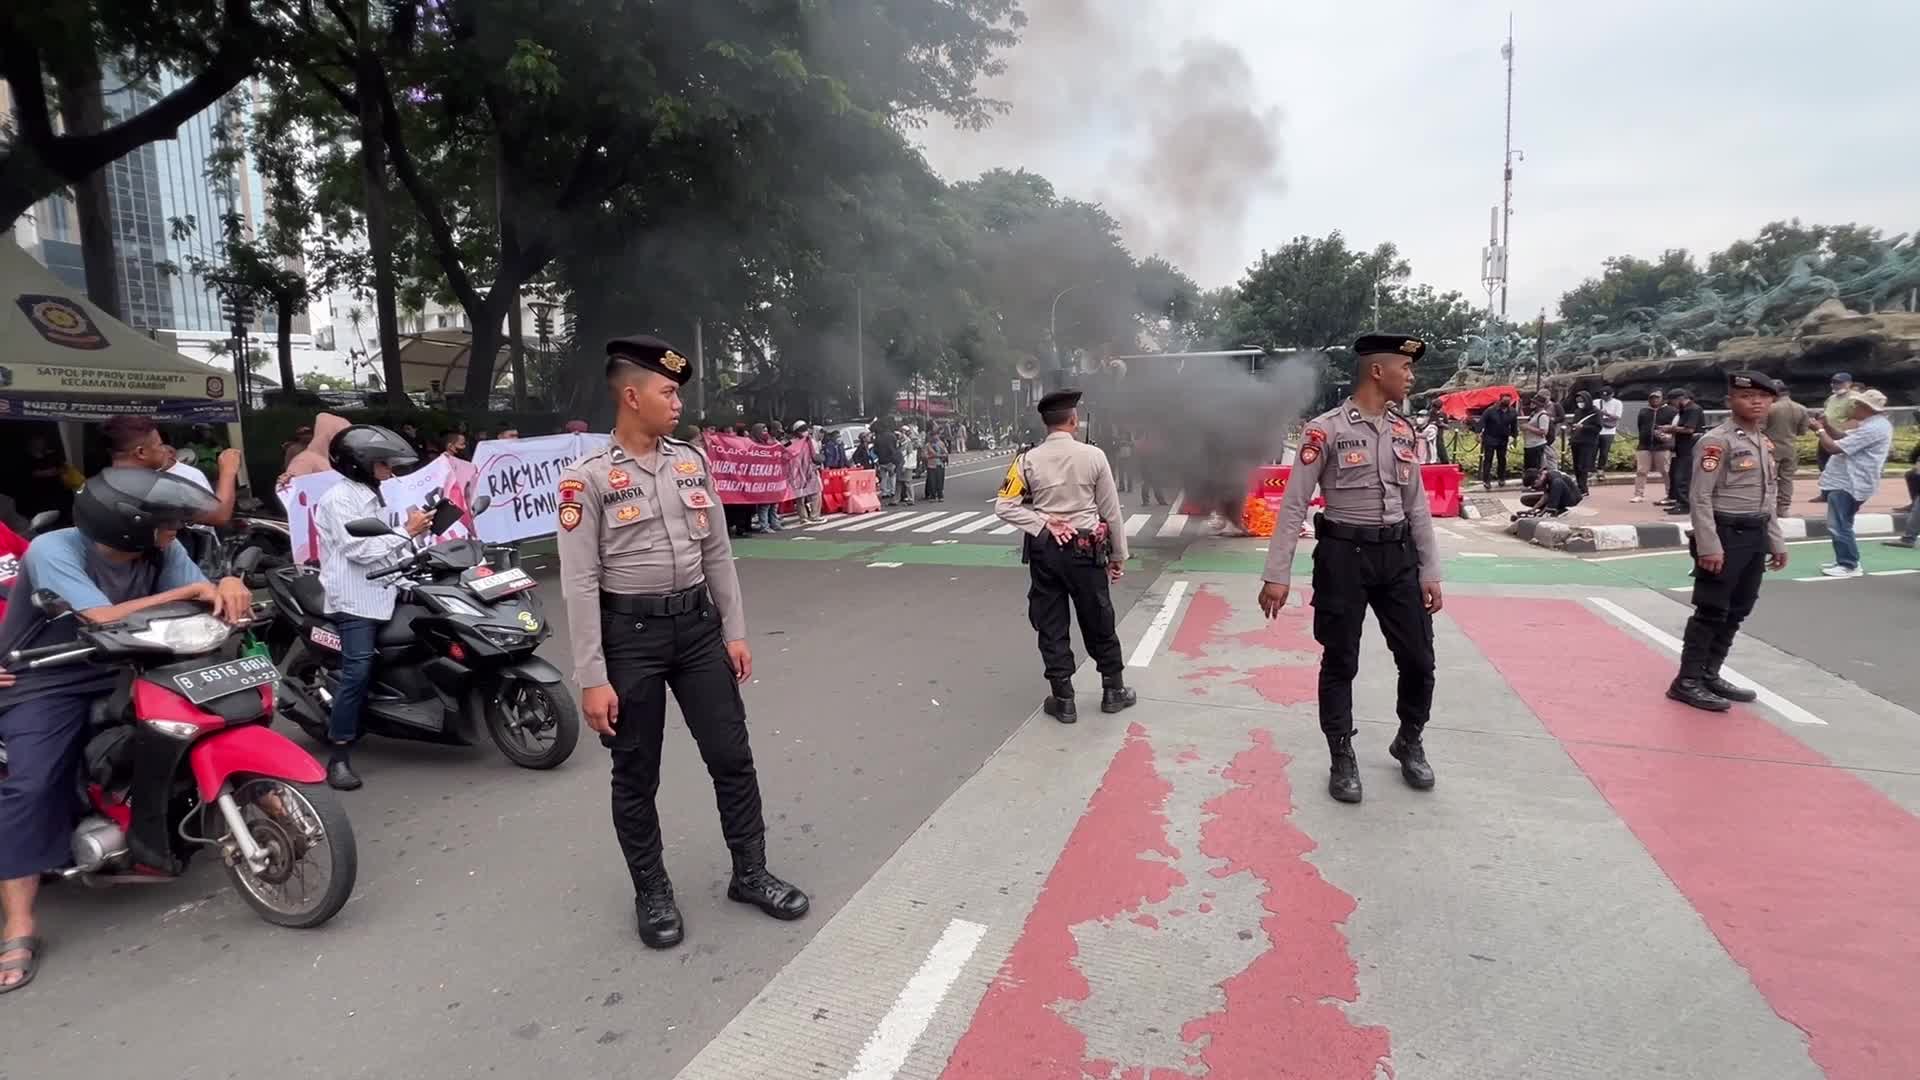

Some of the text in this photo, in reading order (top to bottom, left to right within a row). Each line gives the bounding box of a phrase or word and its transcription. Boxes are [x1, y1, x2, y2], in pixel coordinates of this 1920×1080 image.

[38, 367, 80, 377] SATPOL
[82, 369, 96, 377] PP
[97, 370, 124, 380] PROV
[144, 373, 187, 384] JAKARTA
[61, 377, 126, 389] KECAMATAN
[488, 461, 552, 497] RAKYAT
[179, 677, 194, 689] B
[200, 665, 238, 682] 6916
